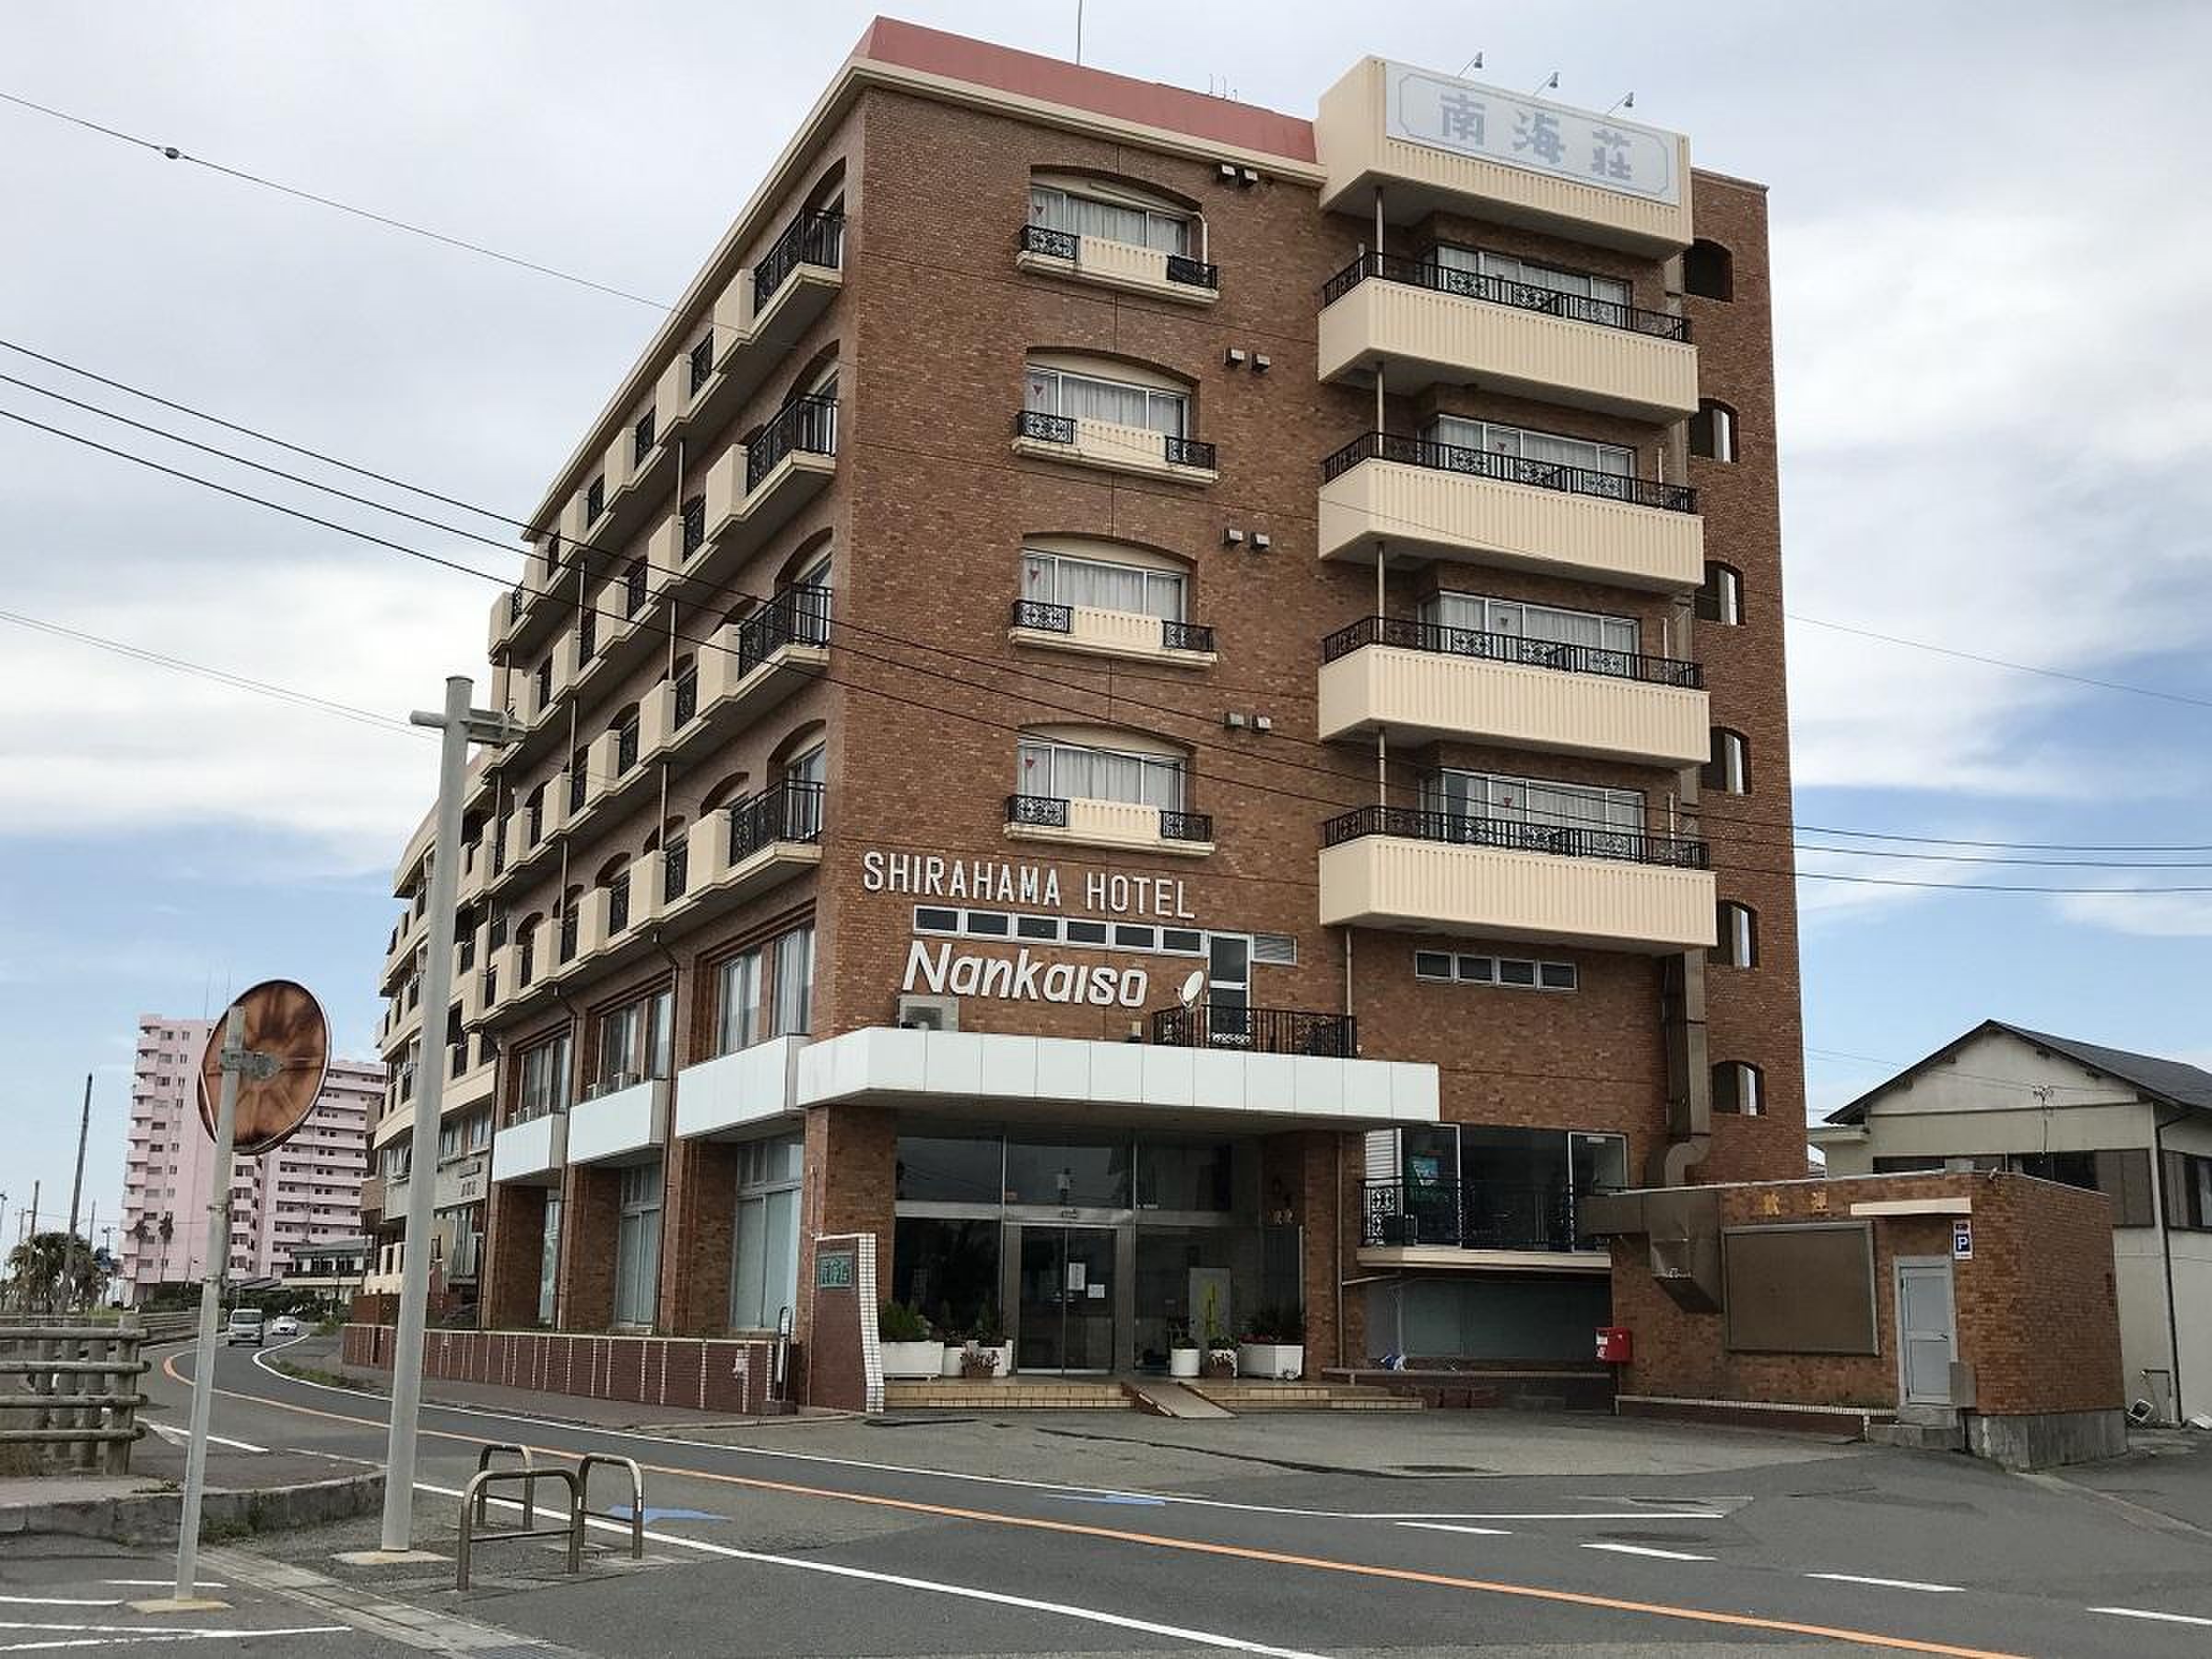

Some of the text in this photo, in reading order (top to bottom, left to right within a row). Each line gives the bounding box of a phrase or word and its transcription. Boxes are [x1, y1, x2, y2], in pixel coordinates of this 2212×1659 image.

[1441, 94, 1630, 180] 南海荘
[863, 851, 1195, 920] SHIRAHAMA HOTEL
[901, 940, 1147, 1007] Nankaiso
[1958, 1236, 1969, 1250] P
